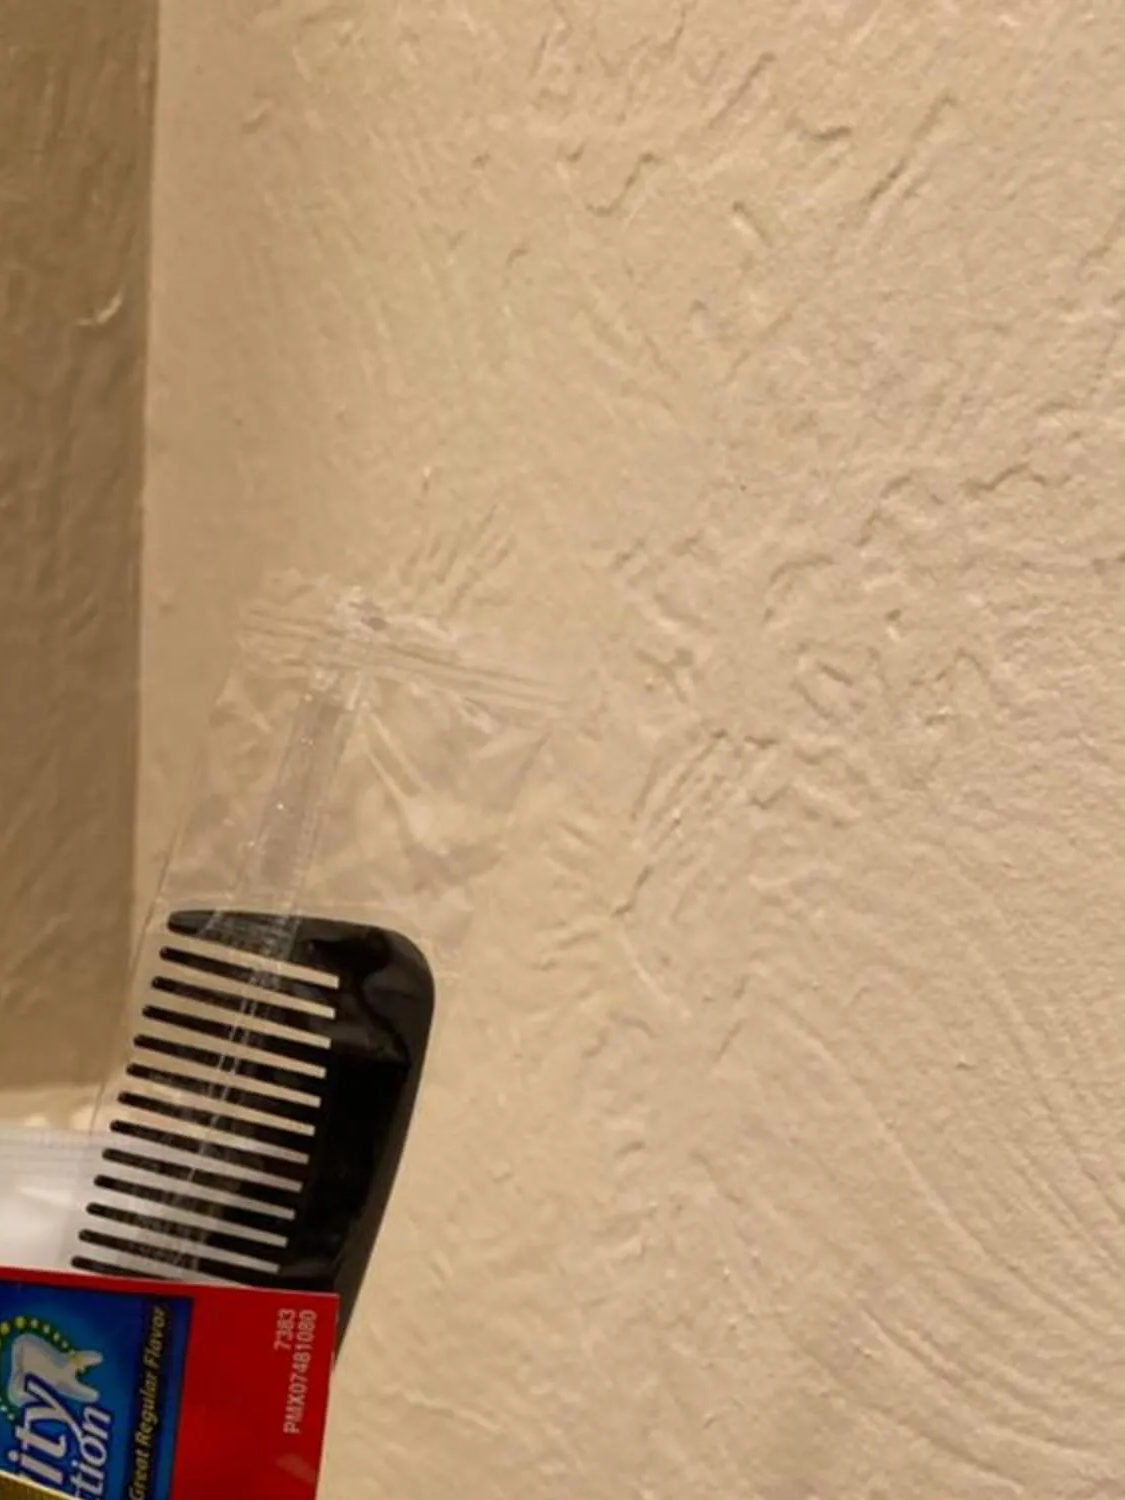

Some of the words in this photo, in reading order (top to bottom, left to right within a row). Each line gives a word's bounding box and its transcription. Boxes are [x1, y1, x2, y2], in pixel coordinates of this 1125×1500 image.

[142, 1305, 166, 1369] Flavor
[7, 1376, 85, 1486] ity
[134, 1370, 159, 1446] Regular
